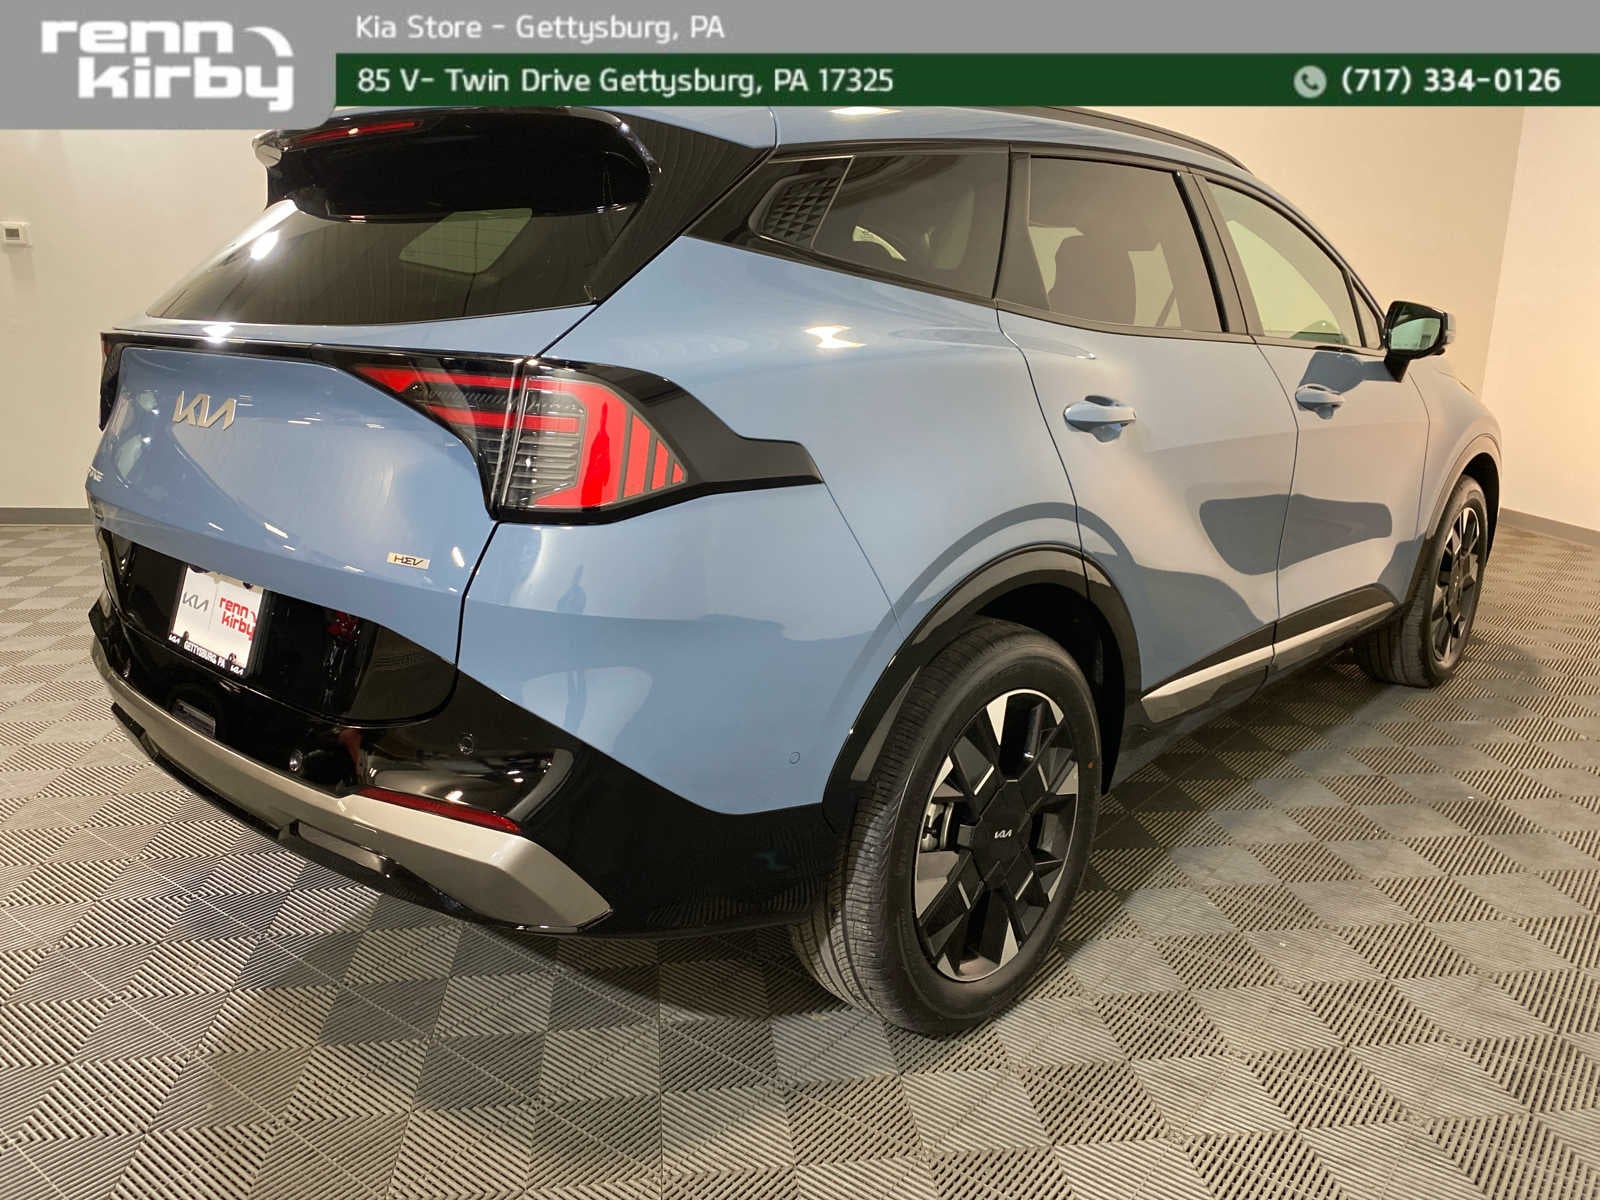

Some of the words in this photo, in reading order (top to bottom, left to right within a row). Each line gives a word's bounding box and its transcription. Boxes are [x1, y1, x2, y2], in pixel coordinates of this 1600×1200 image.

[172, 390, 237, 431] KIA
[394, 554, 424, 567] HEV
[182, 591, 209, 613] KIA
[219, 597, 249, 619] renn
[221, 611, 256, 641] kirby
